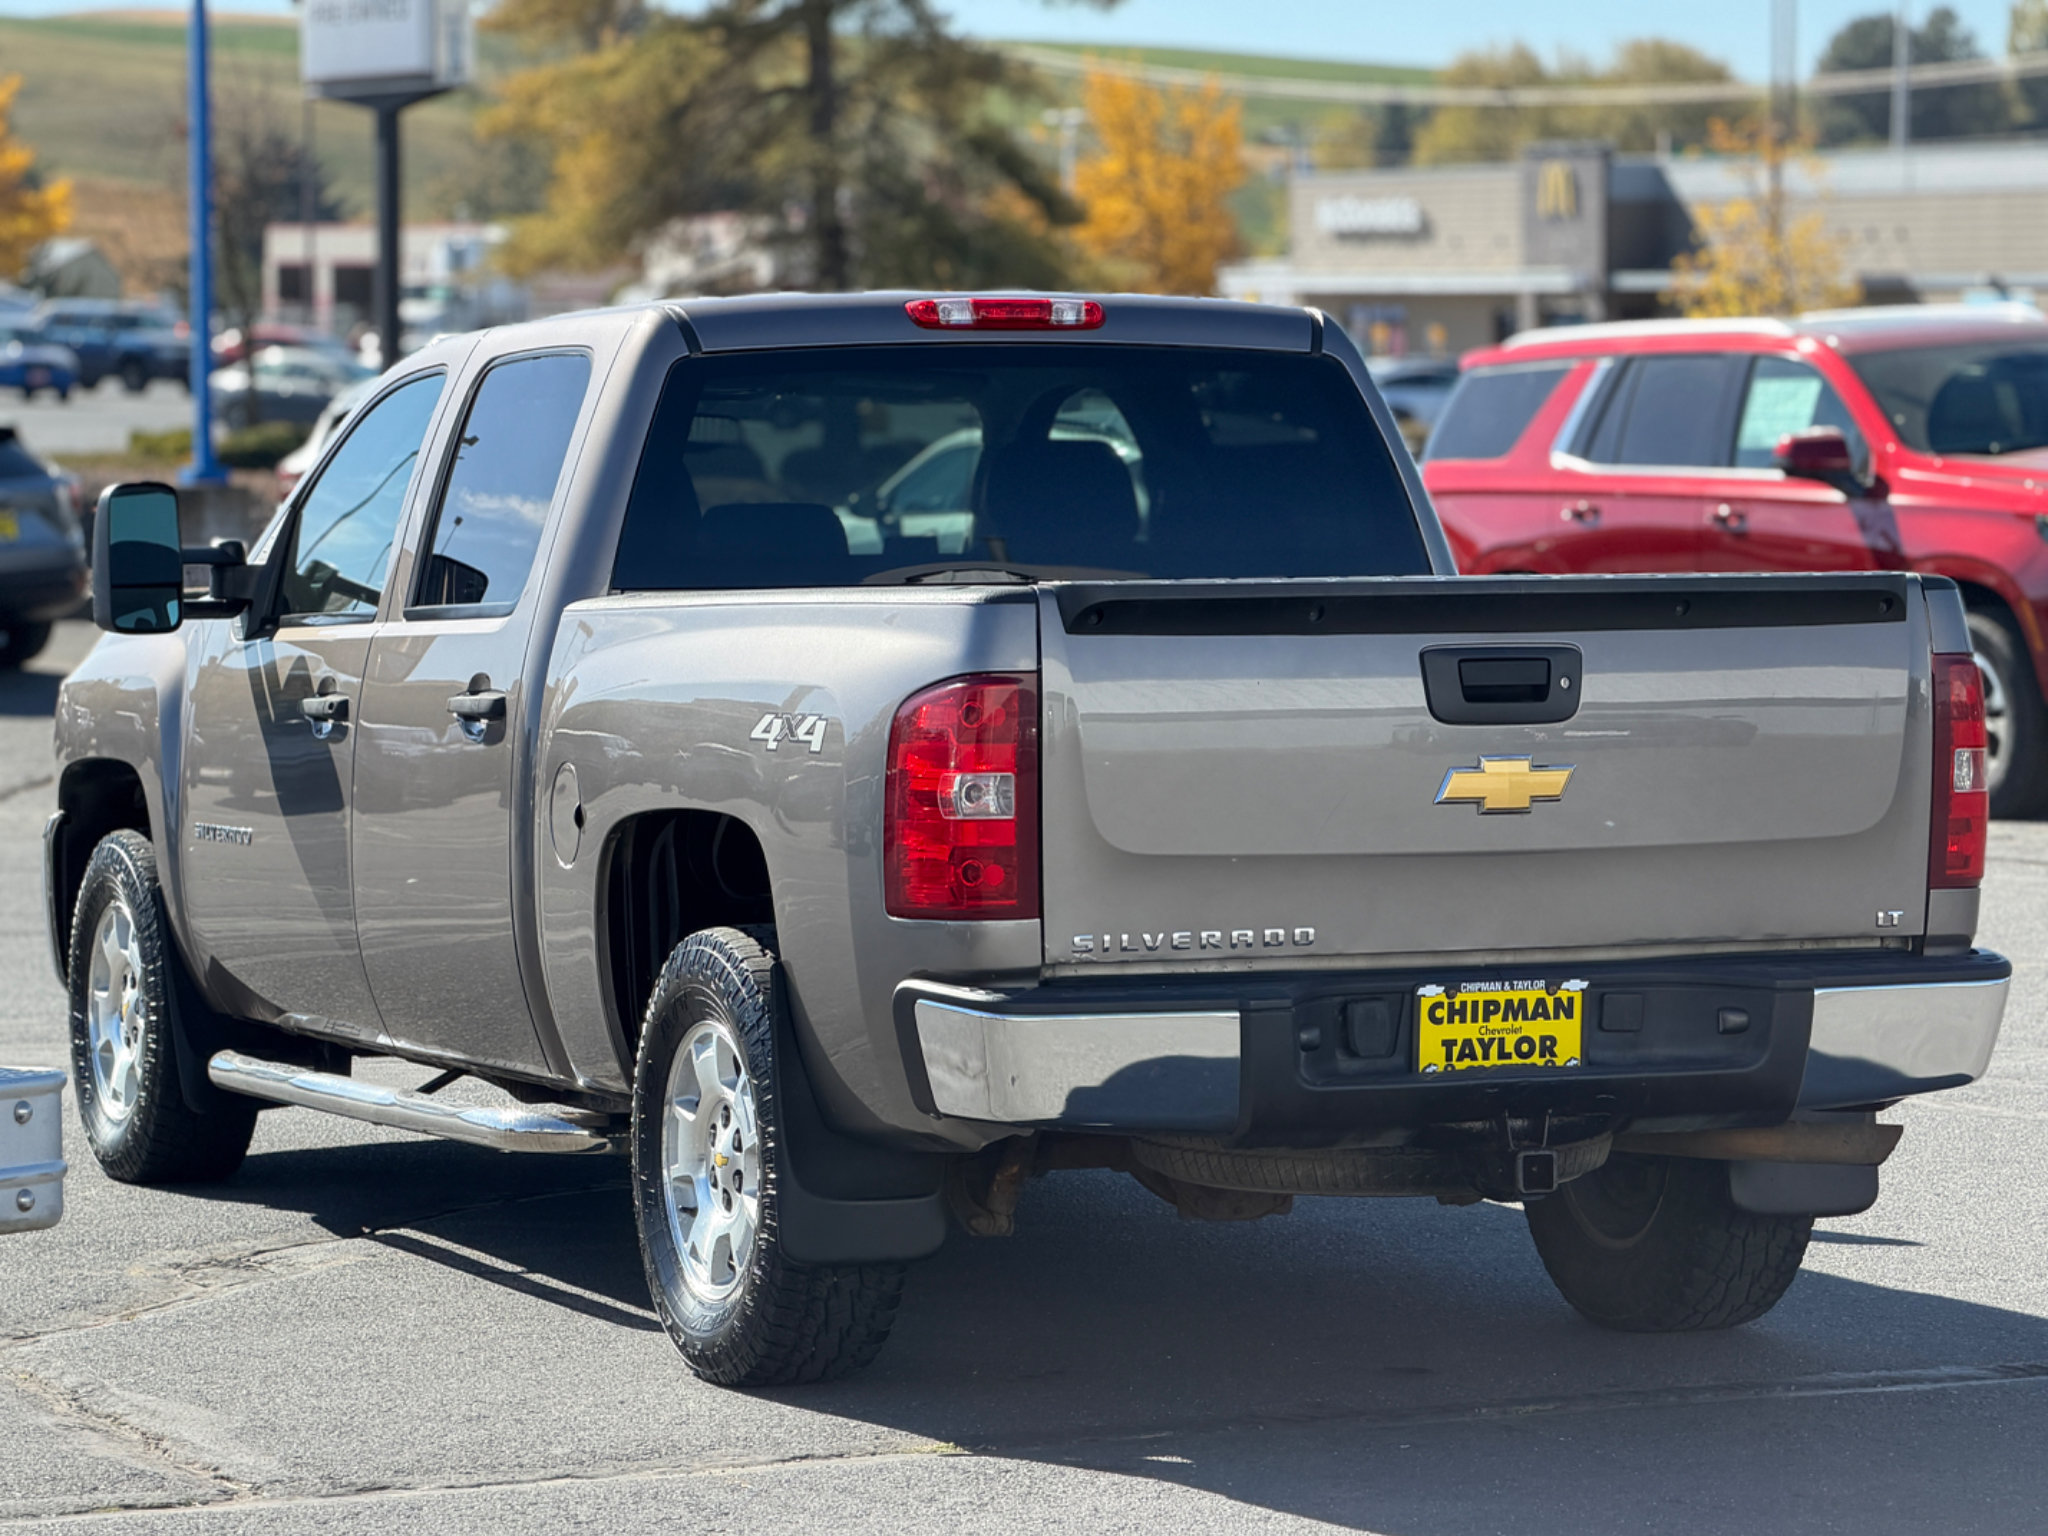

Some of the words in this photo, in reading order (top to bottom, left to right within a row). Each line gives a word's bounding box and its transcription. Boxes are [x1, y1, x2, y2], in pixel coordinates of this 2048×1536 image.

[1876, 910, 1904, 928] LT
[1072, 927, 1315, 953] SILVERADO
[1460, 981, 1501, 993] CHIPMAN
[1503, 980, 1511, 991] &
[1512, 979, 1546, 991] TAYLOR
[1427, 996, 1575, 1026] CHIPMAN
[1478, 1024, 1523, 1036] Chevrolet
[1441, 1035, 1558, 1063] TAYLOR
